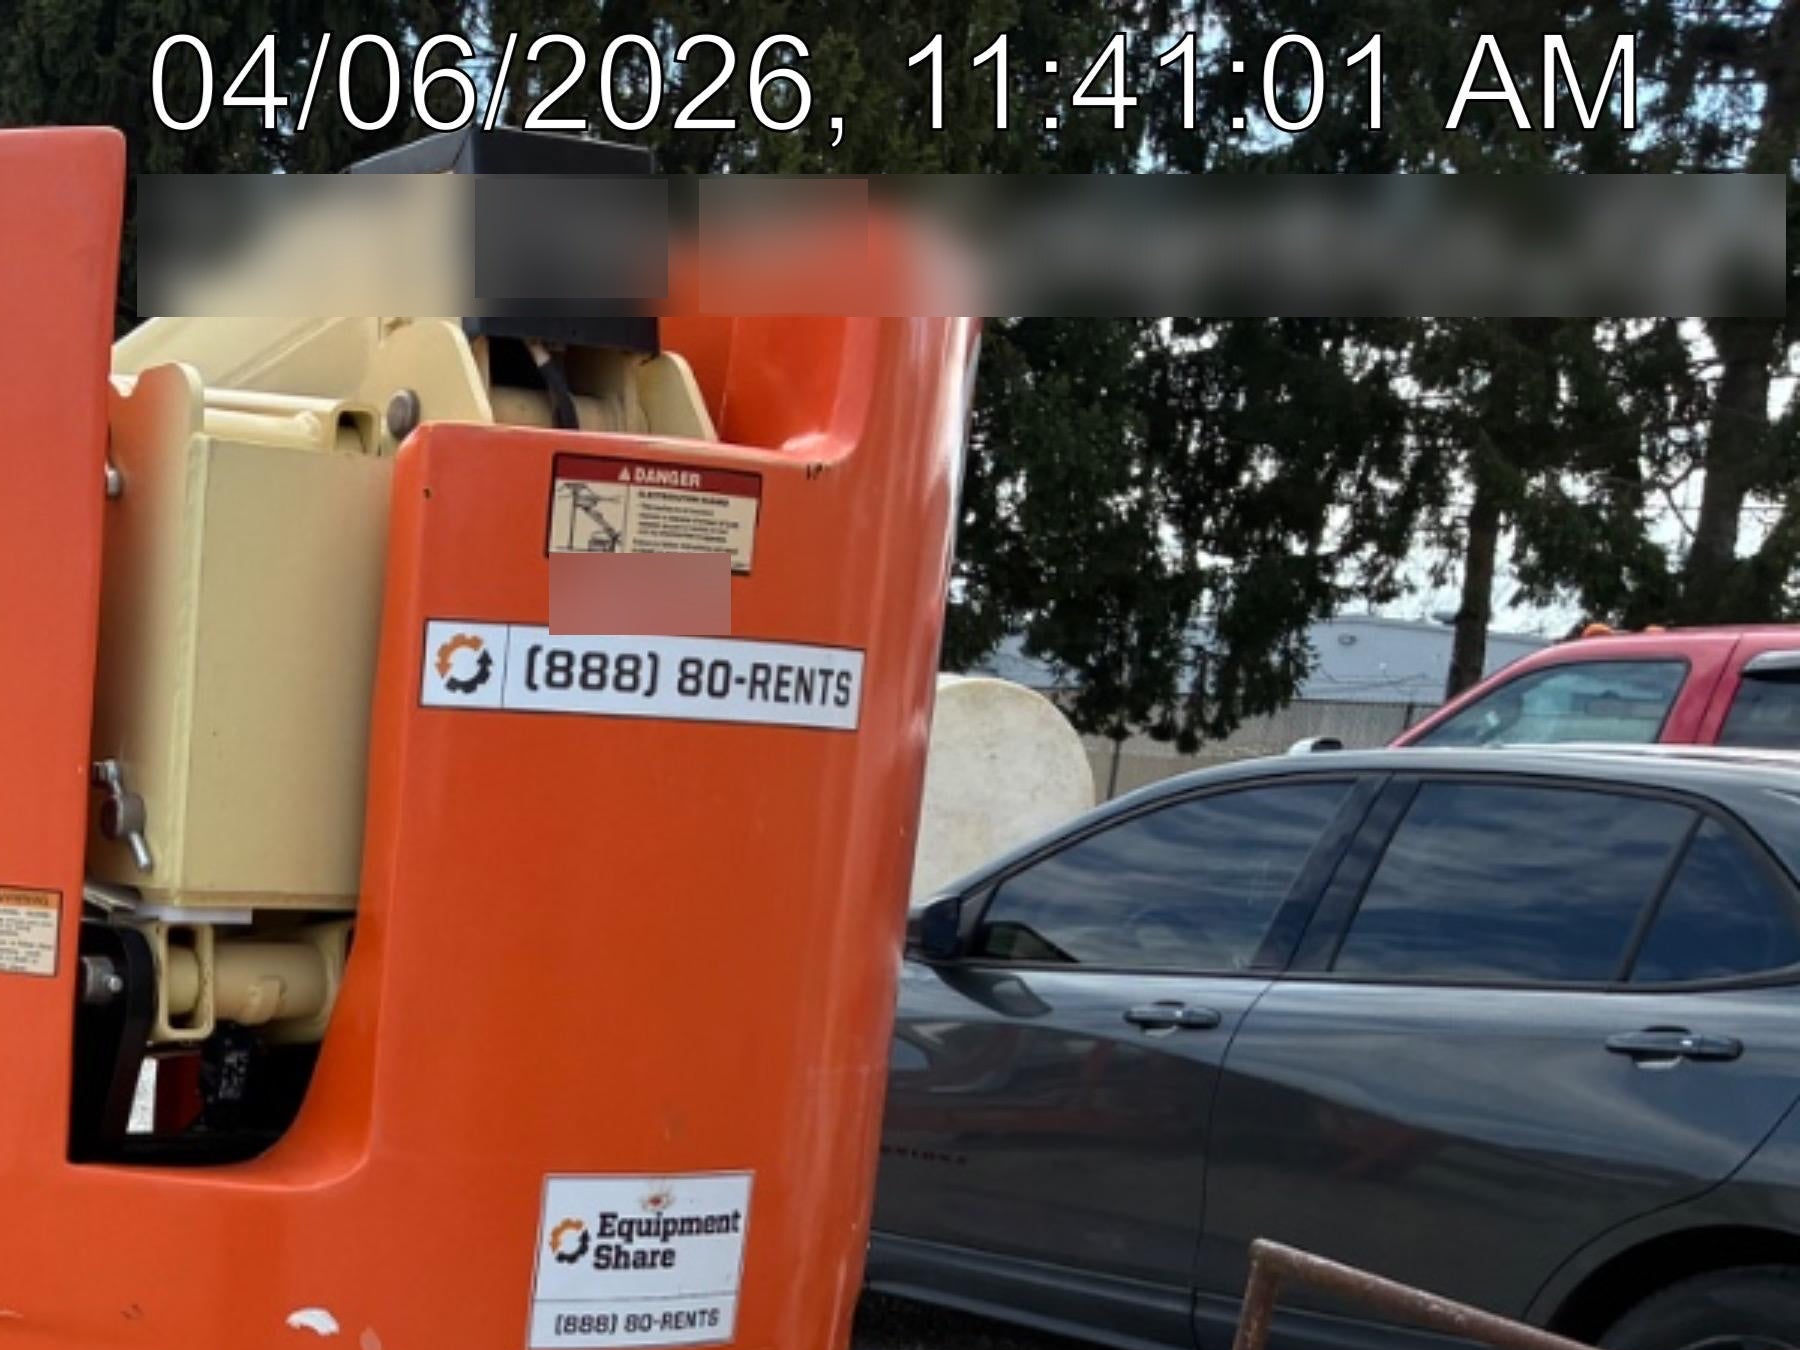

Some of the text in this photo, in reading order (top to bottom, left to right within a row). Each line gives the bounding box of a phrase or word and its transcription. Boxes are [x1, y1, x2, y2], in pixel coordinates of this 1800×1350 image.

[634, 467, 701, 488] DANGER
[524, 644, 853, 709] (888) 80-RENTS
[596, 1208, 741, 1244] Equipment
[593, 1244, 676, 1270] Share
[554, 1308, 720, 1335] (888) 80-RENTS
